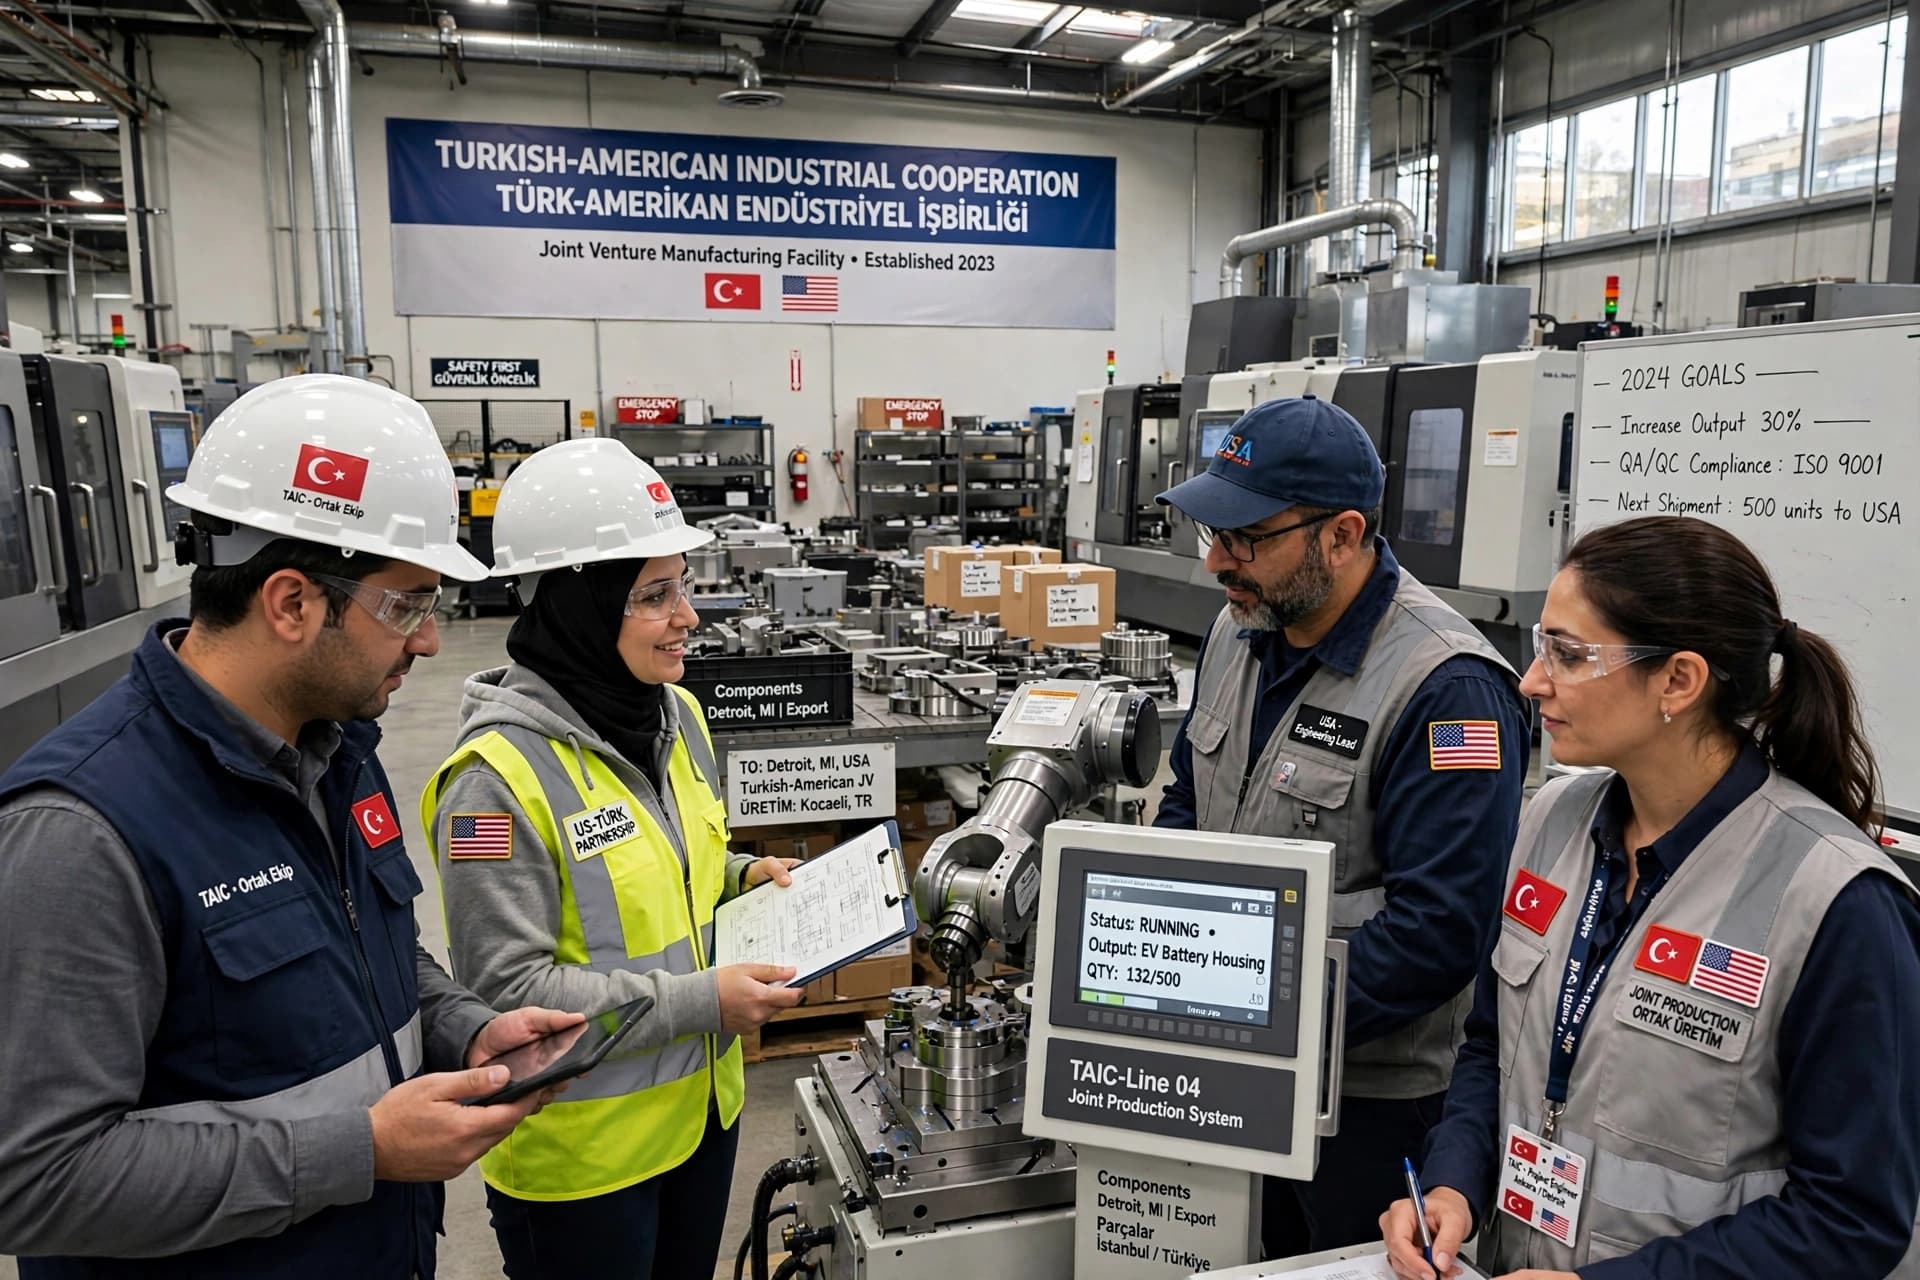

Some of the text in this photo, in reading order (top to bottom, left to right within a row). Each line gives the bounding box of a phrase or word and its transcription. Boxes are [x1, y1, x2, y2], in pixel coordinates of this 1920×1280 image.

[435, 138, 1079, 198] TURKISH-AMERICAN INDUSTRIAL COOPERATION
[496, 178, 1029, 236] TÜRK-AMERİKAN ENDÜSTRİYEL İŞBİRLİĞİ
[539, 240, 995, 272] Joint Venture Manufacturing Facility Established 2023
[434, 371, 489, 385] GÜVENLİK
[447, 360, 522, 373] SAFETY FIRST
[1622, 363, 1746, 391] 2024 GOALS
[618, 398, 677, 408] EMERGENCY
[635, 409, 660, 420] STOP
[885, 400, 941, 411] EMERGENCY
[906, 411, 929, 421] STOP
[1620, 408, 1802, 440] Increase Output 30%
[1219, 435, 1254, 461] USA
[1619, 448, 1680, 476] QA/QC
[1793, 453, 1828, 474] ISO
[1838, 453, 1883, 475] 9001
[283, 489, 307, 504] TAIC
[313, 497, 341, 512] Ortak
[342, 503, 365, 519] Ekip
[1617, 492, 1650, 512] Next
[1743, 496, 1776, 517] 500
[1784, 498, 1823, 520] units
[1834, 499, 1852, 520] to
[1862, 501, 1902, 524] USA
[715, 682, 803, 700] Components
[707, 704, 756, 720] Detroit,
[760, 703, 775, 717] MI
[786, 701, 829, 717] Export
[1319, 714, 1337, 730] USA
[1294, 723, 1358, 750] Engineering Lead
[739, 754, 871, 775] TO: Detroit, MI, USA
[740, 773, 874, 795] Turkish-American JV
[800, 795, 852, 812] Kocaeli,
[855, 794, 873, 808] TR
[573, 806, 628, 837] US-TÜRK
[575, 820, 636, 855] PARTNERSHIP
[198, 863, 294, 909] TAIC Ortak Ekip
[1089, 912, 1200, 938] Status: RUNNING
[1088, 936, 1265, 974] Output: EV Battery Housing
[1087, 962, 1181, 988] QTY: 132/500
[1629, 985, 1662, 1006] JOINT
[1661, 996, 1741, 1035] PRODUCTION
[1632, 1004, 1674, 1030] ORTAK
[1070, 1058, 1201, 1098] TAIC-Line 04
[1067, 1088, 1243, 1129] Joint Production System
[1097, 1170, 1191, 1200] Components
[1098, 1193, 1145, 1217] Detroit,
[1149, 1202, 1163, 1217] MI
[1175, 1206, 1216, 1227] Export
[1097, 1216, 1154, 1240] Parçalar
[1097, 1233, 1211, 1273] İstanbul / Türkiye
